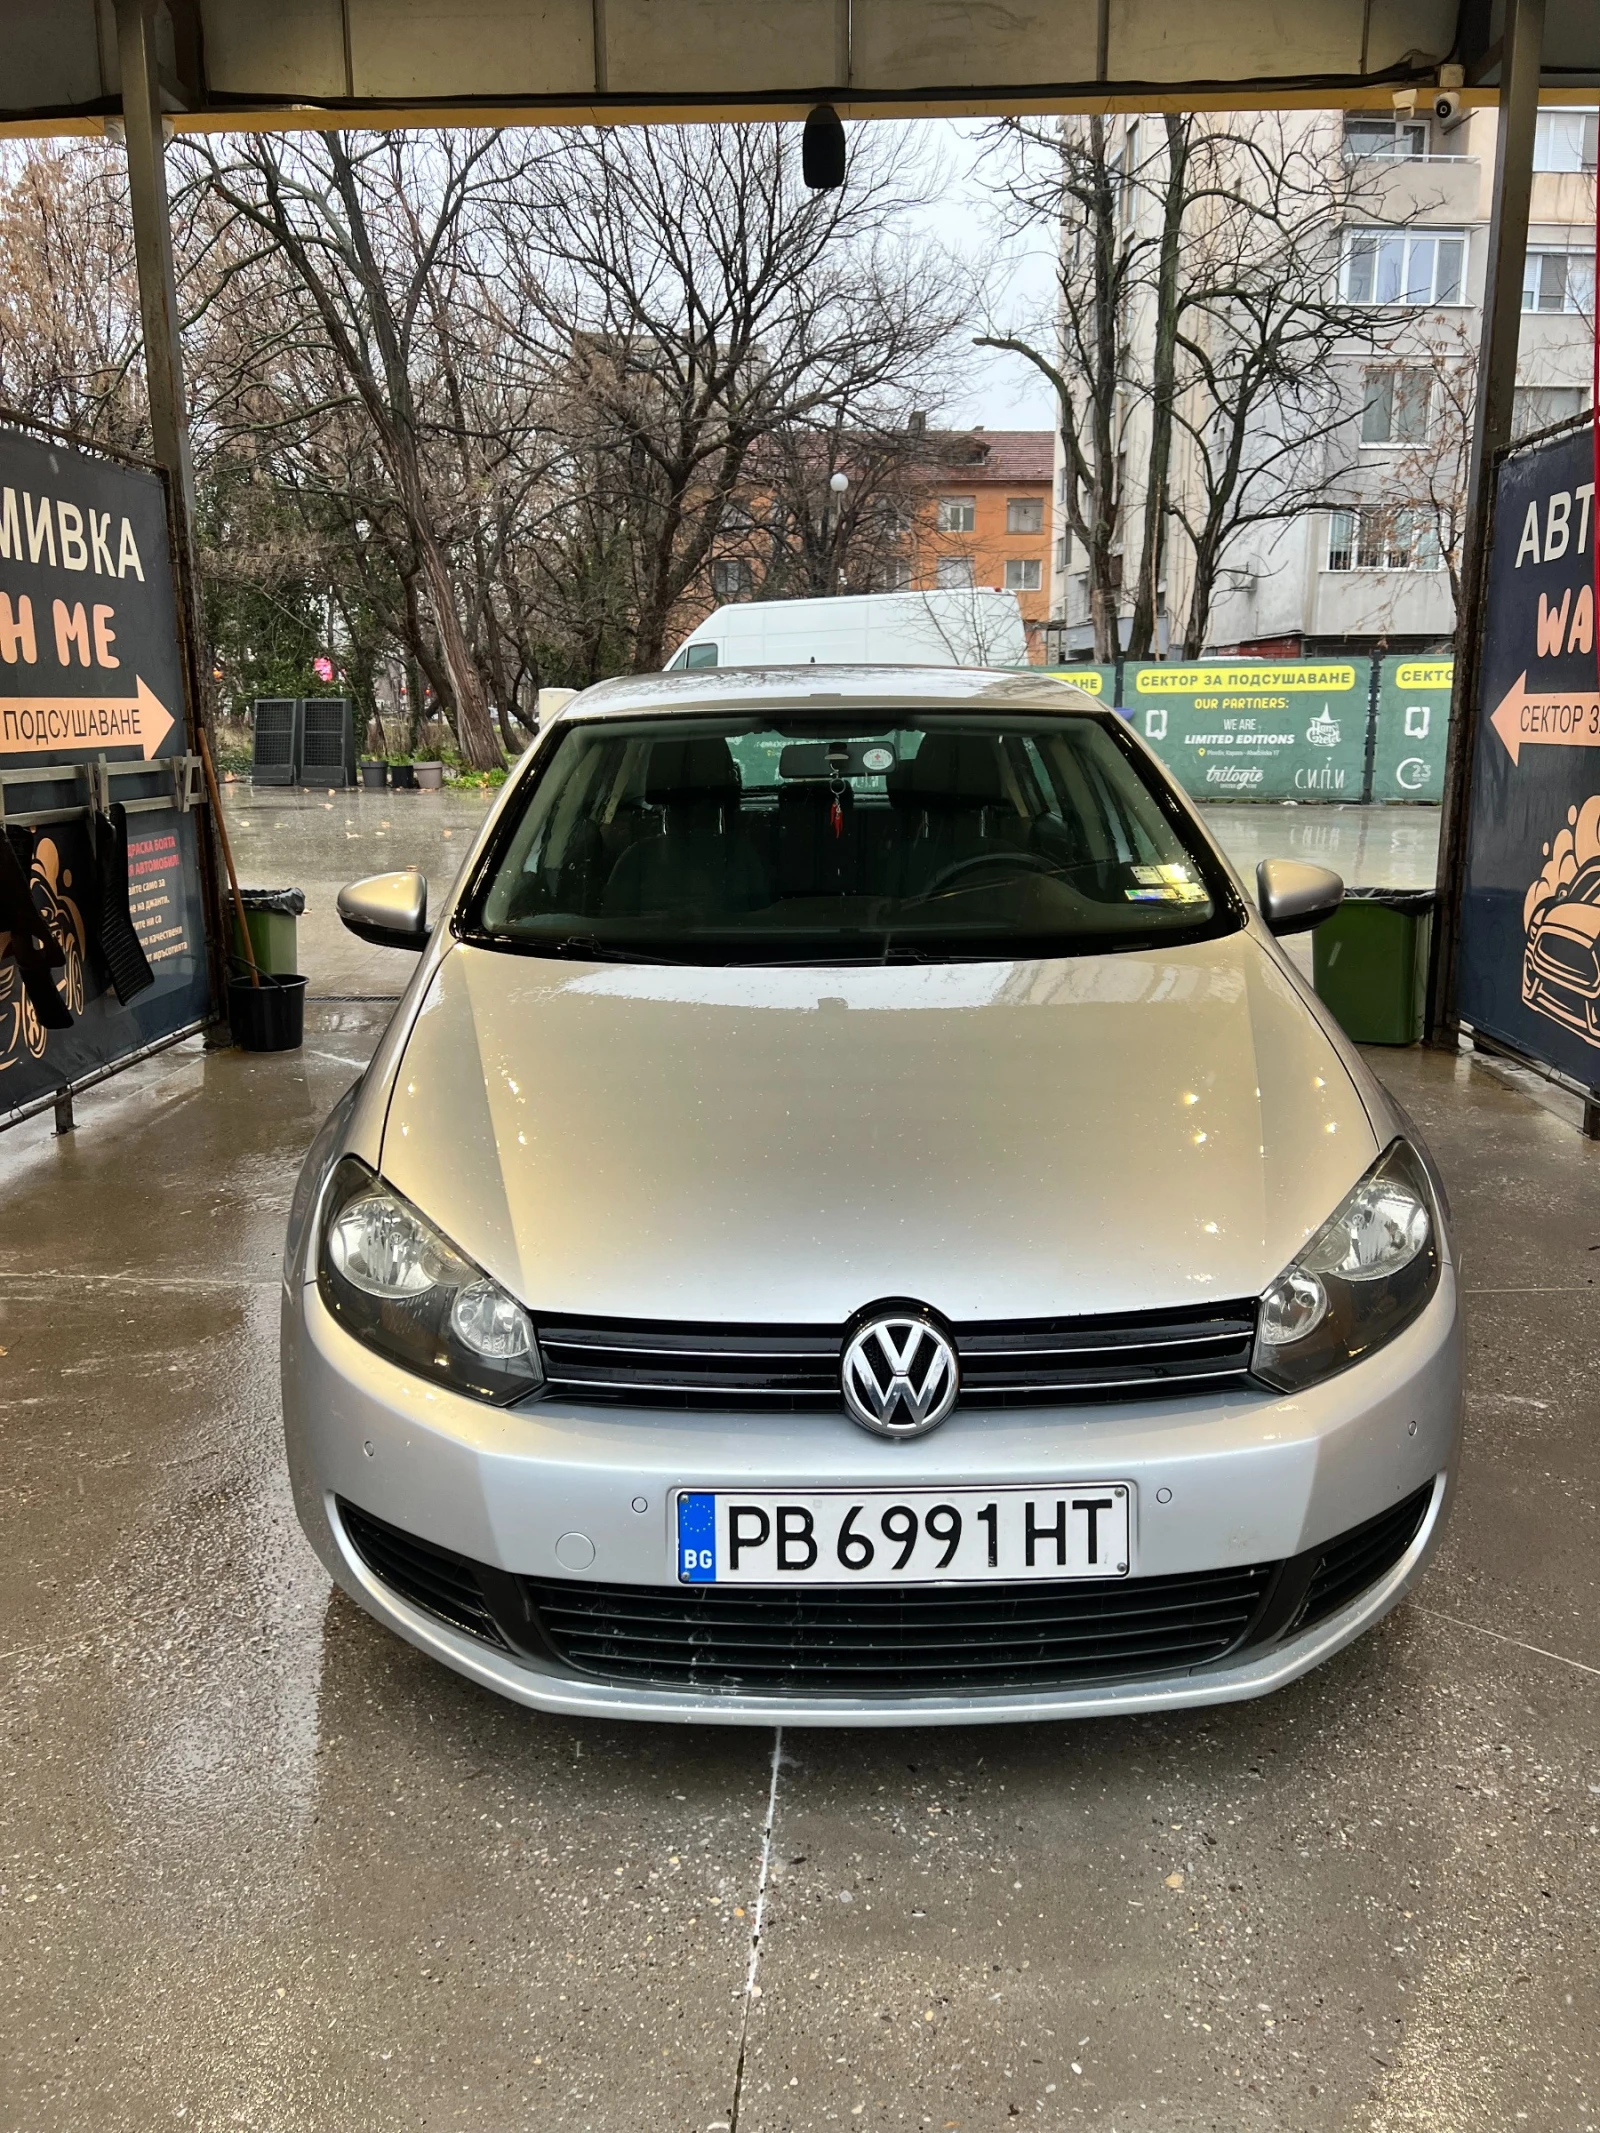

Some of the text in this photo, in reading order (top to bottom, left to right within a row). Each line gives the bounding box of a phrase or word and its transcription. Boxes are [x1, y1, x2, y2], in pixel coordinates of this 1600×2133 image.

[52, 598, 120, 669] ME
[1141, 672, 1351, 687] СЕКТОР ЗА ПОДСУШАВАНЕ
[1194, 697, 1290, 710] OUR PARTNERS:
[3, 709, 142, 745] ПОДСУШАВАНЕ
[1223, 718, 1257, 731] WE ARE
[1520, 704, 1600, 734] СЕКТОР З
[1184, 733, 1296, 745] LIMITED EDITIONS
[1206, 764, 1264, 790] trilogie
[837, 1502, 997, 1571] 6991
[684, 1549, 713, 1569] BG
